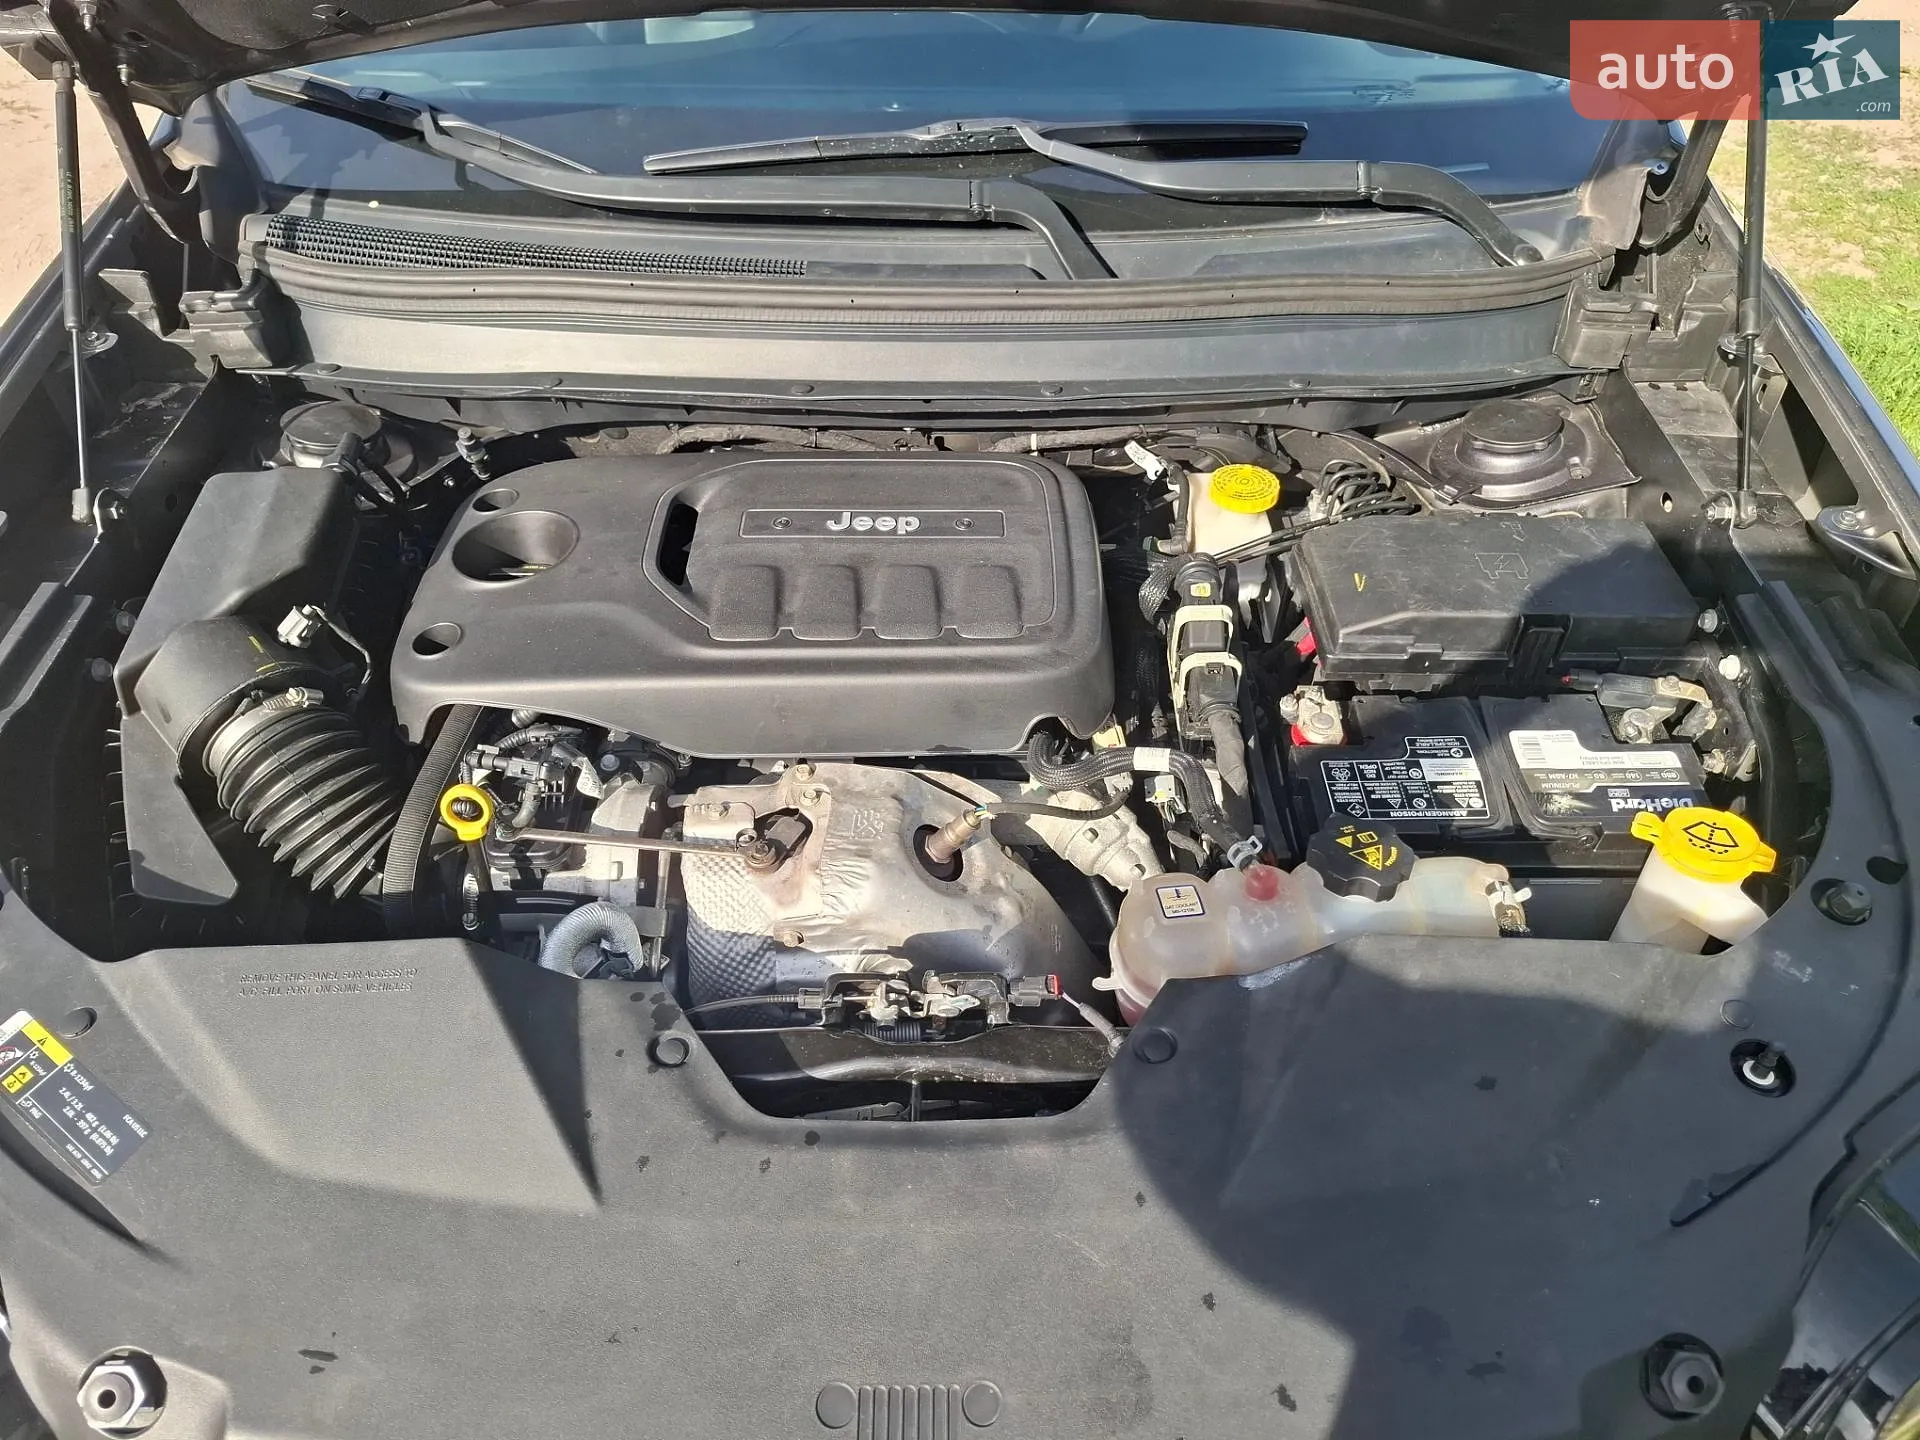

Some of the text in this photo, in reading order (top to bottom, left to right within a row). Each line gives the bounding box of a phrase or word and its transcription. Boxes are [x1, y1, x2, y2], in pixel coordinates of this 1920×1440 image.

[826, 511, 921, 535] Jeep
[1608, 797, 1694, 812] DieHard
[239, 967, 418, 983] REMOVE THIS PANEL FOR ACCESS TO
[262, 986, 282, 996] FILL
[286, 985, 311, 996] PORT
[315, 984, 331, 995] ON
[331, 983, 362, 993] SOME
